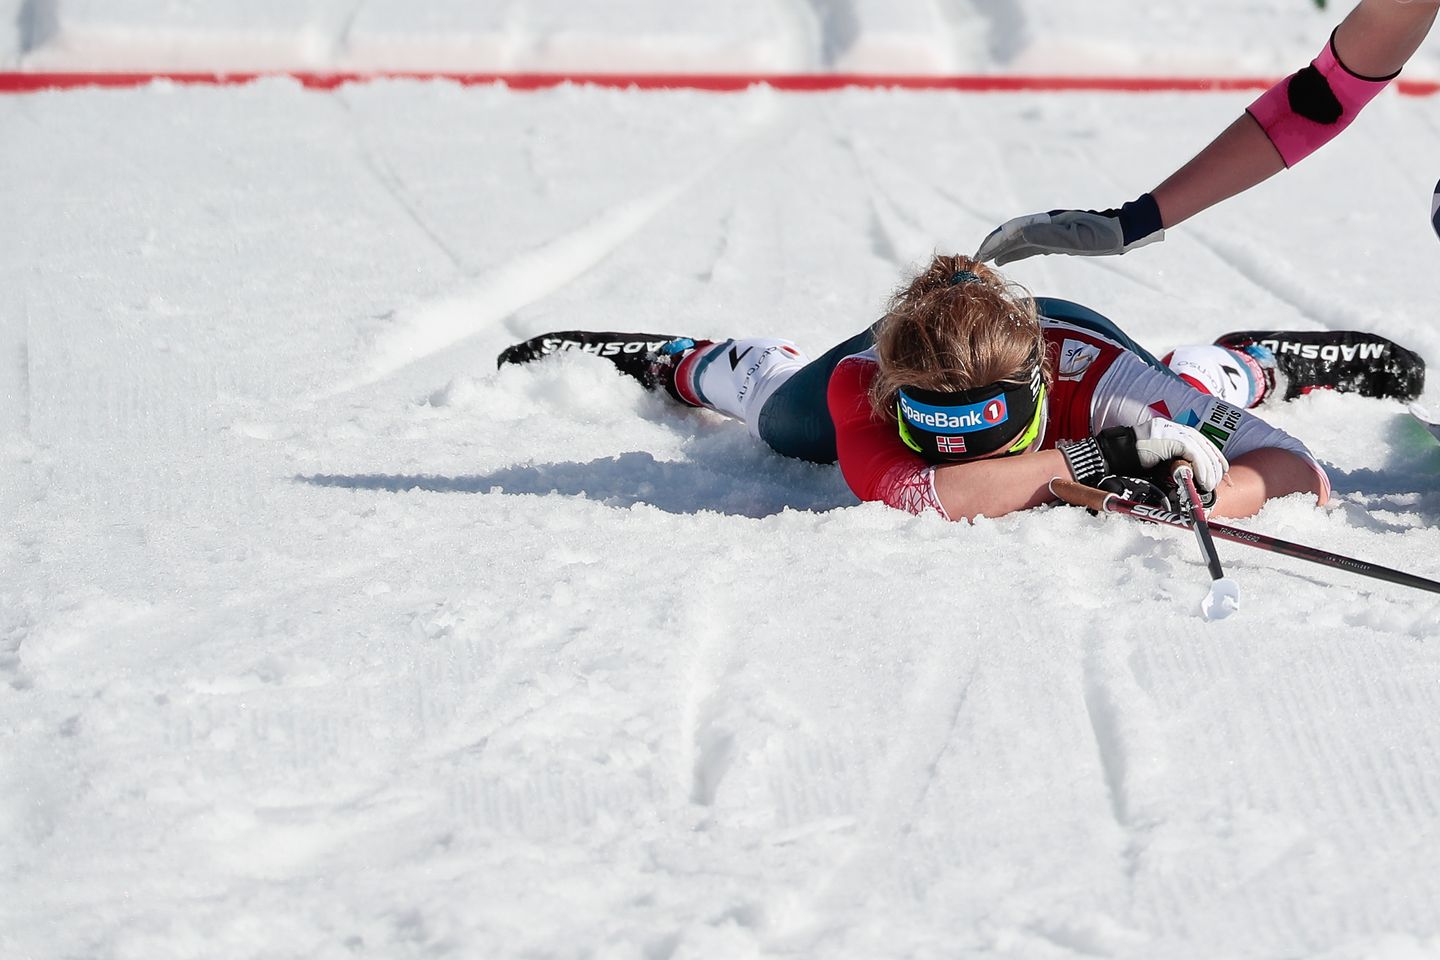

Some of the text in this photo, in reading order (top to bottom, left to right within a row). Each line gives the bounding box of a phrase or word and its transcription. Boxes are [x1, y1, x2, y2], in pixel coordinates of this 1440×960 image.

[1252, 338, 1385, 362] MADSHU
[900, 397, 999, 428] SpareBank 1
[1210, 401, 1230, 424] mini
[1222, 410, 1242, 431] pris
